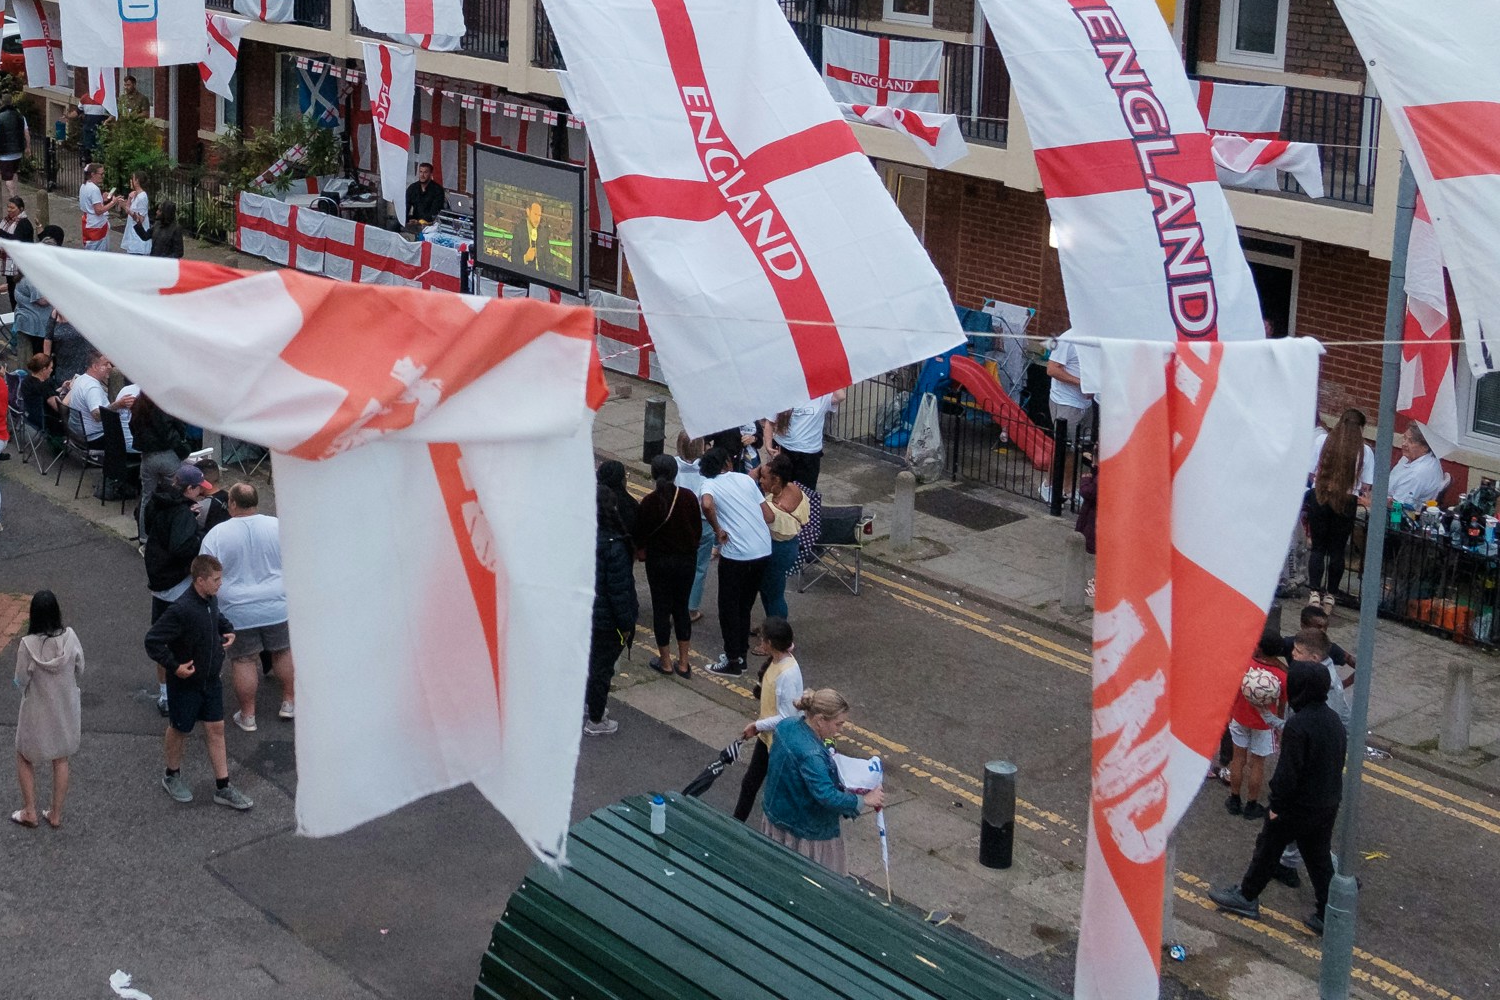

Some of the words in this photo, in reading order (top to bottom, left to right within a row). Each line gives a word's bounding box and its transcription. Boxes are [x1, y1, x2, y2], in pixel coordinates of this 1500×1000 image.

[851, 72, 914, 93] ENGLAND
[1074, 7, 1218, 338] ENGLAND
[682, 86, 803, 280] ENGLAND
